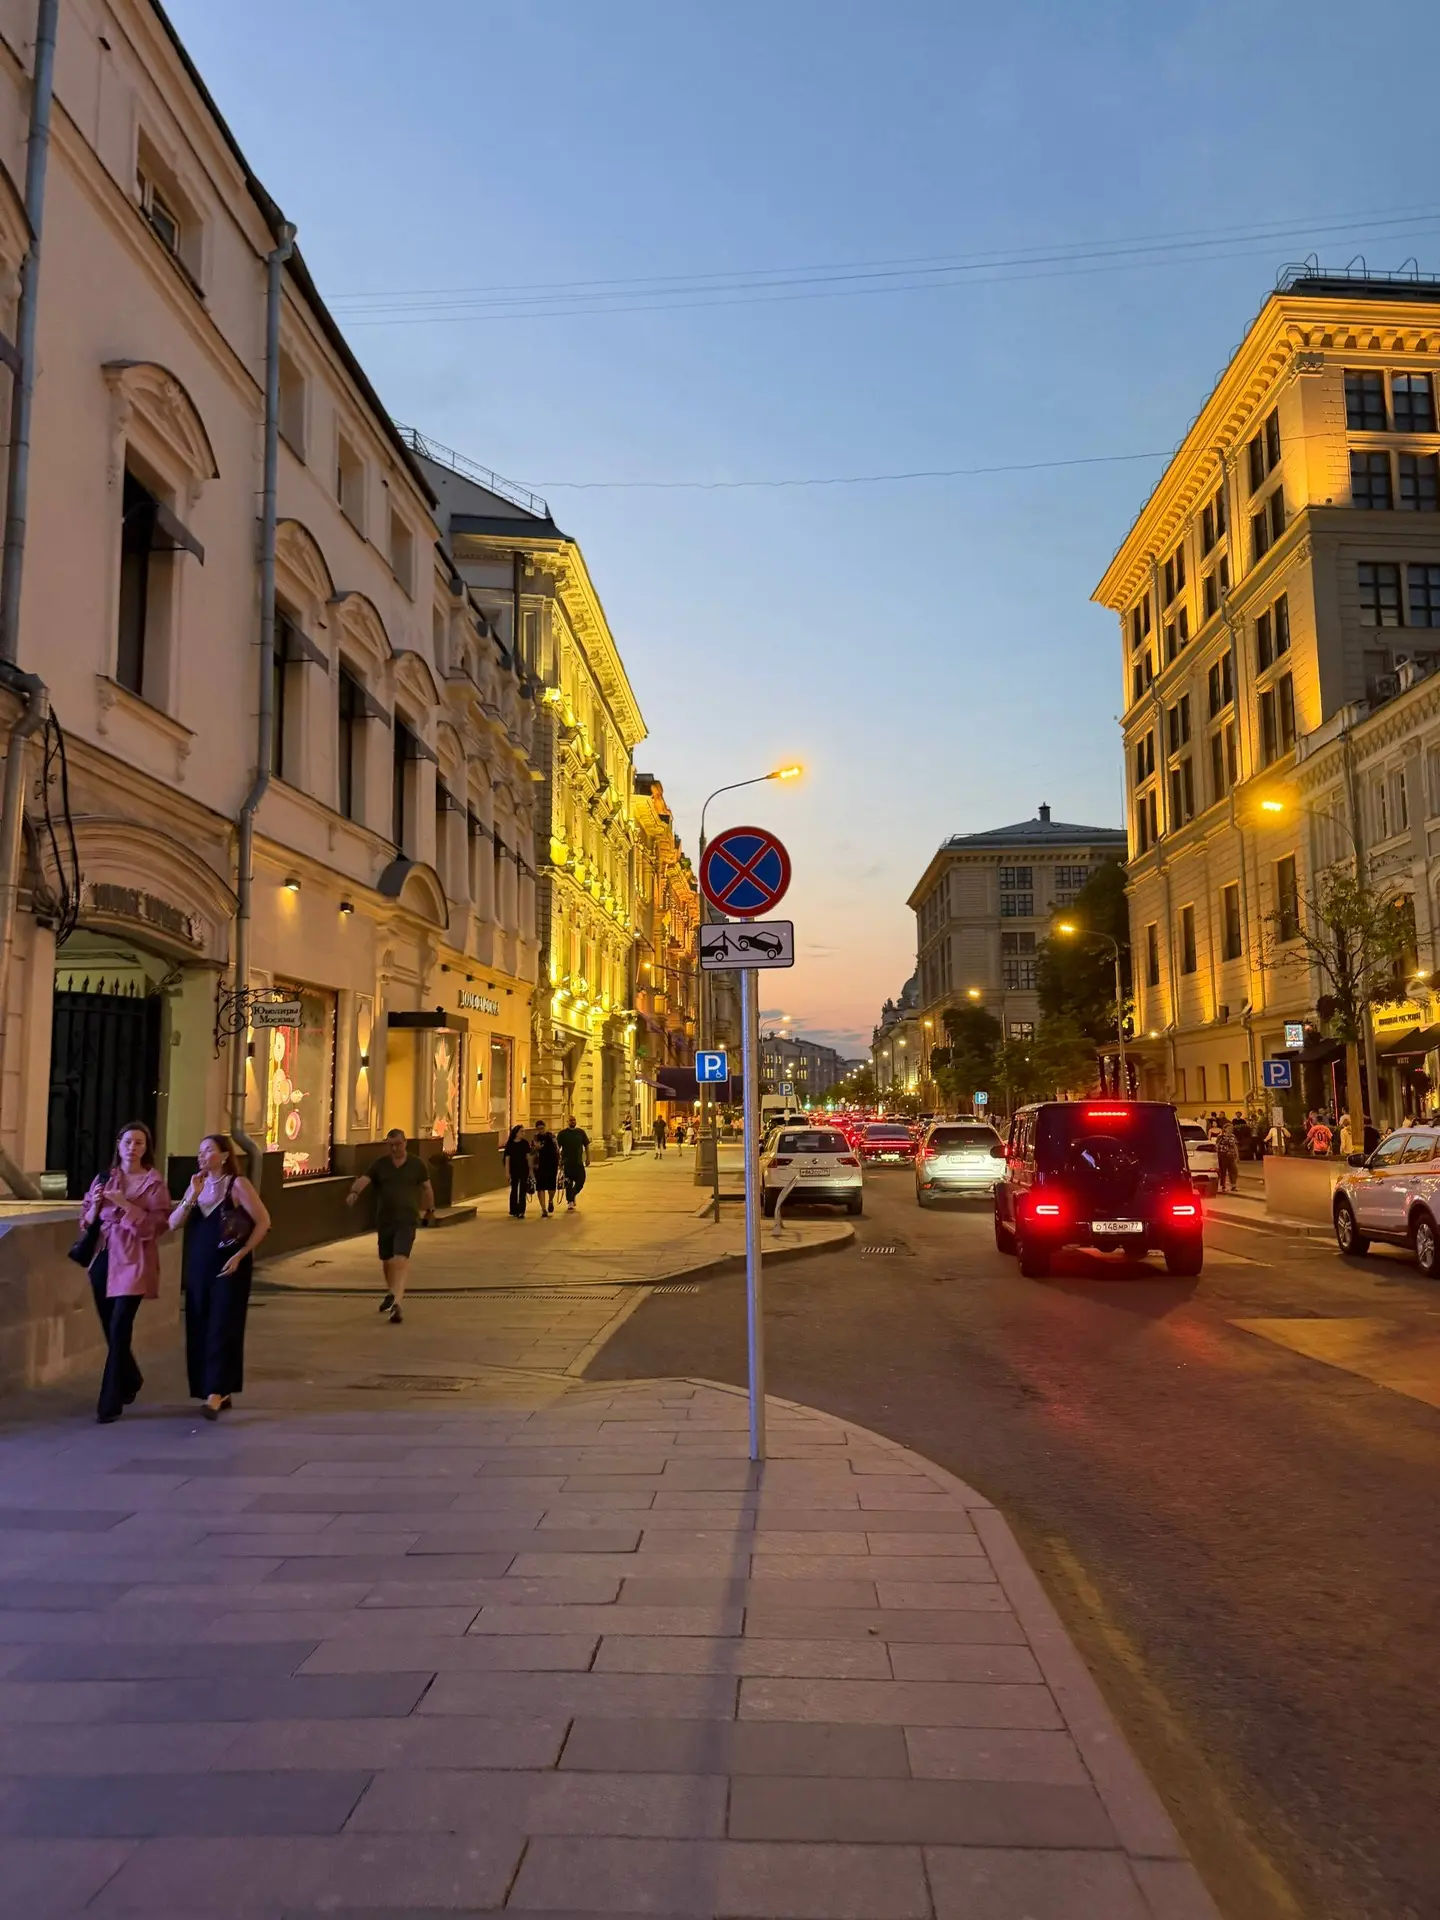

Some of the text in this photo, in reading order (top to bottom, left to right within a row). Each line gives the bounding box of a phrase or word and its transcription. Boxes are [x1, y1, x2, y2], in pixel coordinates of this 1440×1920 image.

[704, 1055, 722, 1079] P
[1270, 1063, 1286, 1085] P
[783, 1084, 792, 1095] P
[978, 1092, 986, 1103] P
